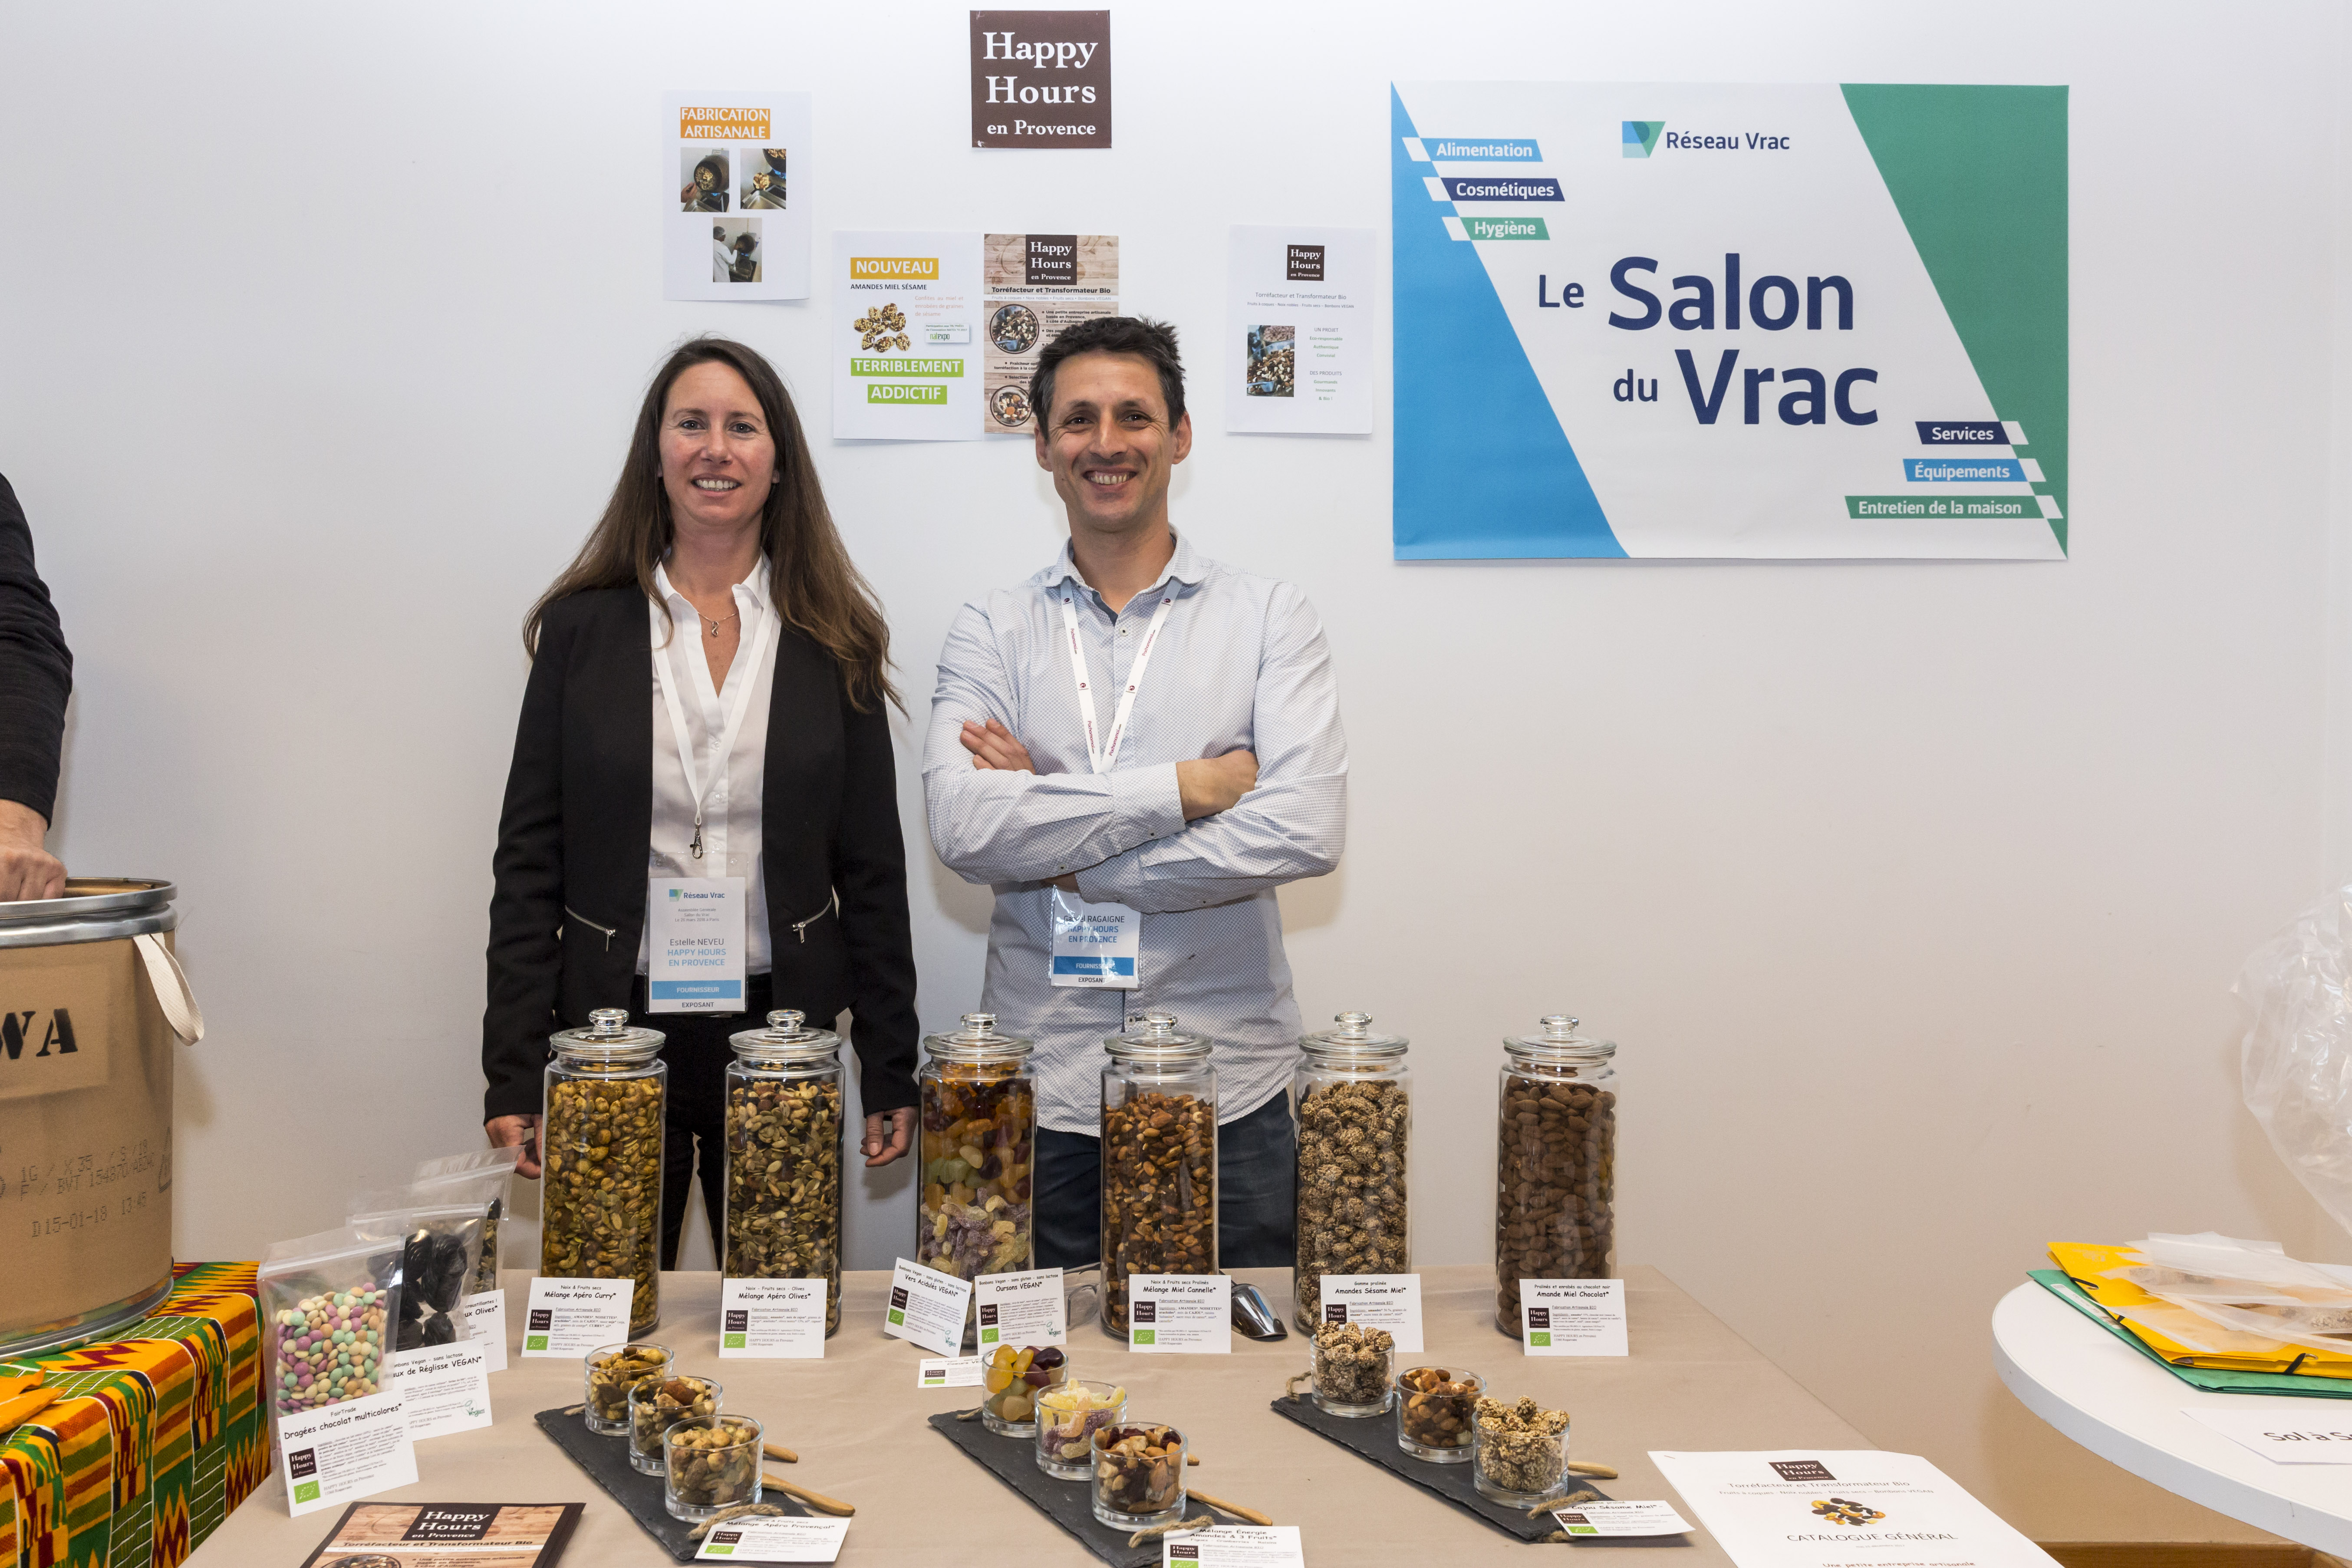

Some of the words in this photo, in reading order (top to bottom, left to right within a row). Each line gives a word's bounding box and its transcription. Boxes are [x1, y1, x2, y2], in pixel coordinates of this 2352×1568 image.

[983, 32, 1098, 68] Happy
[985, 76, 1096, 103] Hours
[681, 108, 768, 122] FABRICATION
[685, 125, 765, 139] ARTISANALE
[987, 125, 1008, 134] en
[1014, 120, 1096, 135] Provence
[1667, 131, 1738, 149] Réseau
[1746, 133, 1789, 149] Vrac
[1436, 142, 1532, 156] Alimentation
[1456, 181, 1555, 200] Cosmétiques
[1475, 221, 1535, 237] Hygiène
[1031, 242, 1072, 256] Happy
[1291, 249, 1321, 260] Happy
[857, 261, 932, 273] NOUVEAU
[1031, 258, 1071, 268] Hours
[1539, 274, 1584, 309] Le
[1608, 253, 1853, 332] Salon
[854, 360, 960, 372] TERRIBLEMENT
[871, 386, 940, 399] ADDICTIF
[1613, 369, 1658, 402] du
[1674, 349, 1878, 426] Vrac
[1933, 427, 1993, 440] Services
[1915, 462, 2009, 481] Équipements
[1859, 501, 1924, 514] Entretien
[1929, 501, 1946, 514] de
[1951, 501, 1963, 514] la
[1968, 501, 2021, 514] maison
[905, 1274, 916, 1282] Vers
[917, 1278, 937, 1290] Acidulés
[419, 1364, 448, 1373] Réglisse
[331, 1407, 356, 1416] FairTrade
[285, 1427, 316, 1439] Dragées
[320, 1417, 351, 1430] chocolat
[2263, 1432, 2311, 1441] Sol
[2306, 1432, 2332, 1441] à
[424, 1512, 490, 1522] Happy
[1885, 1532, 1958, 1541] GÉNÉRAL
